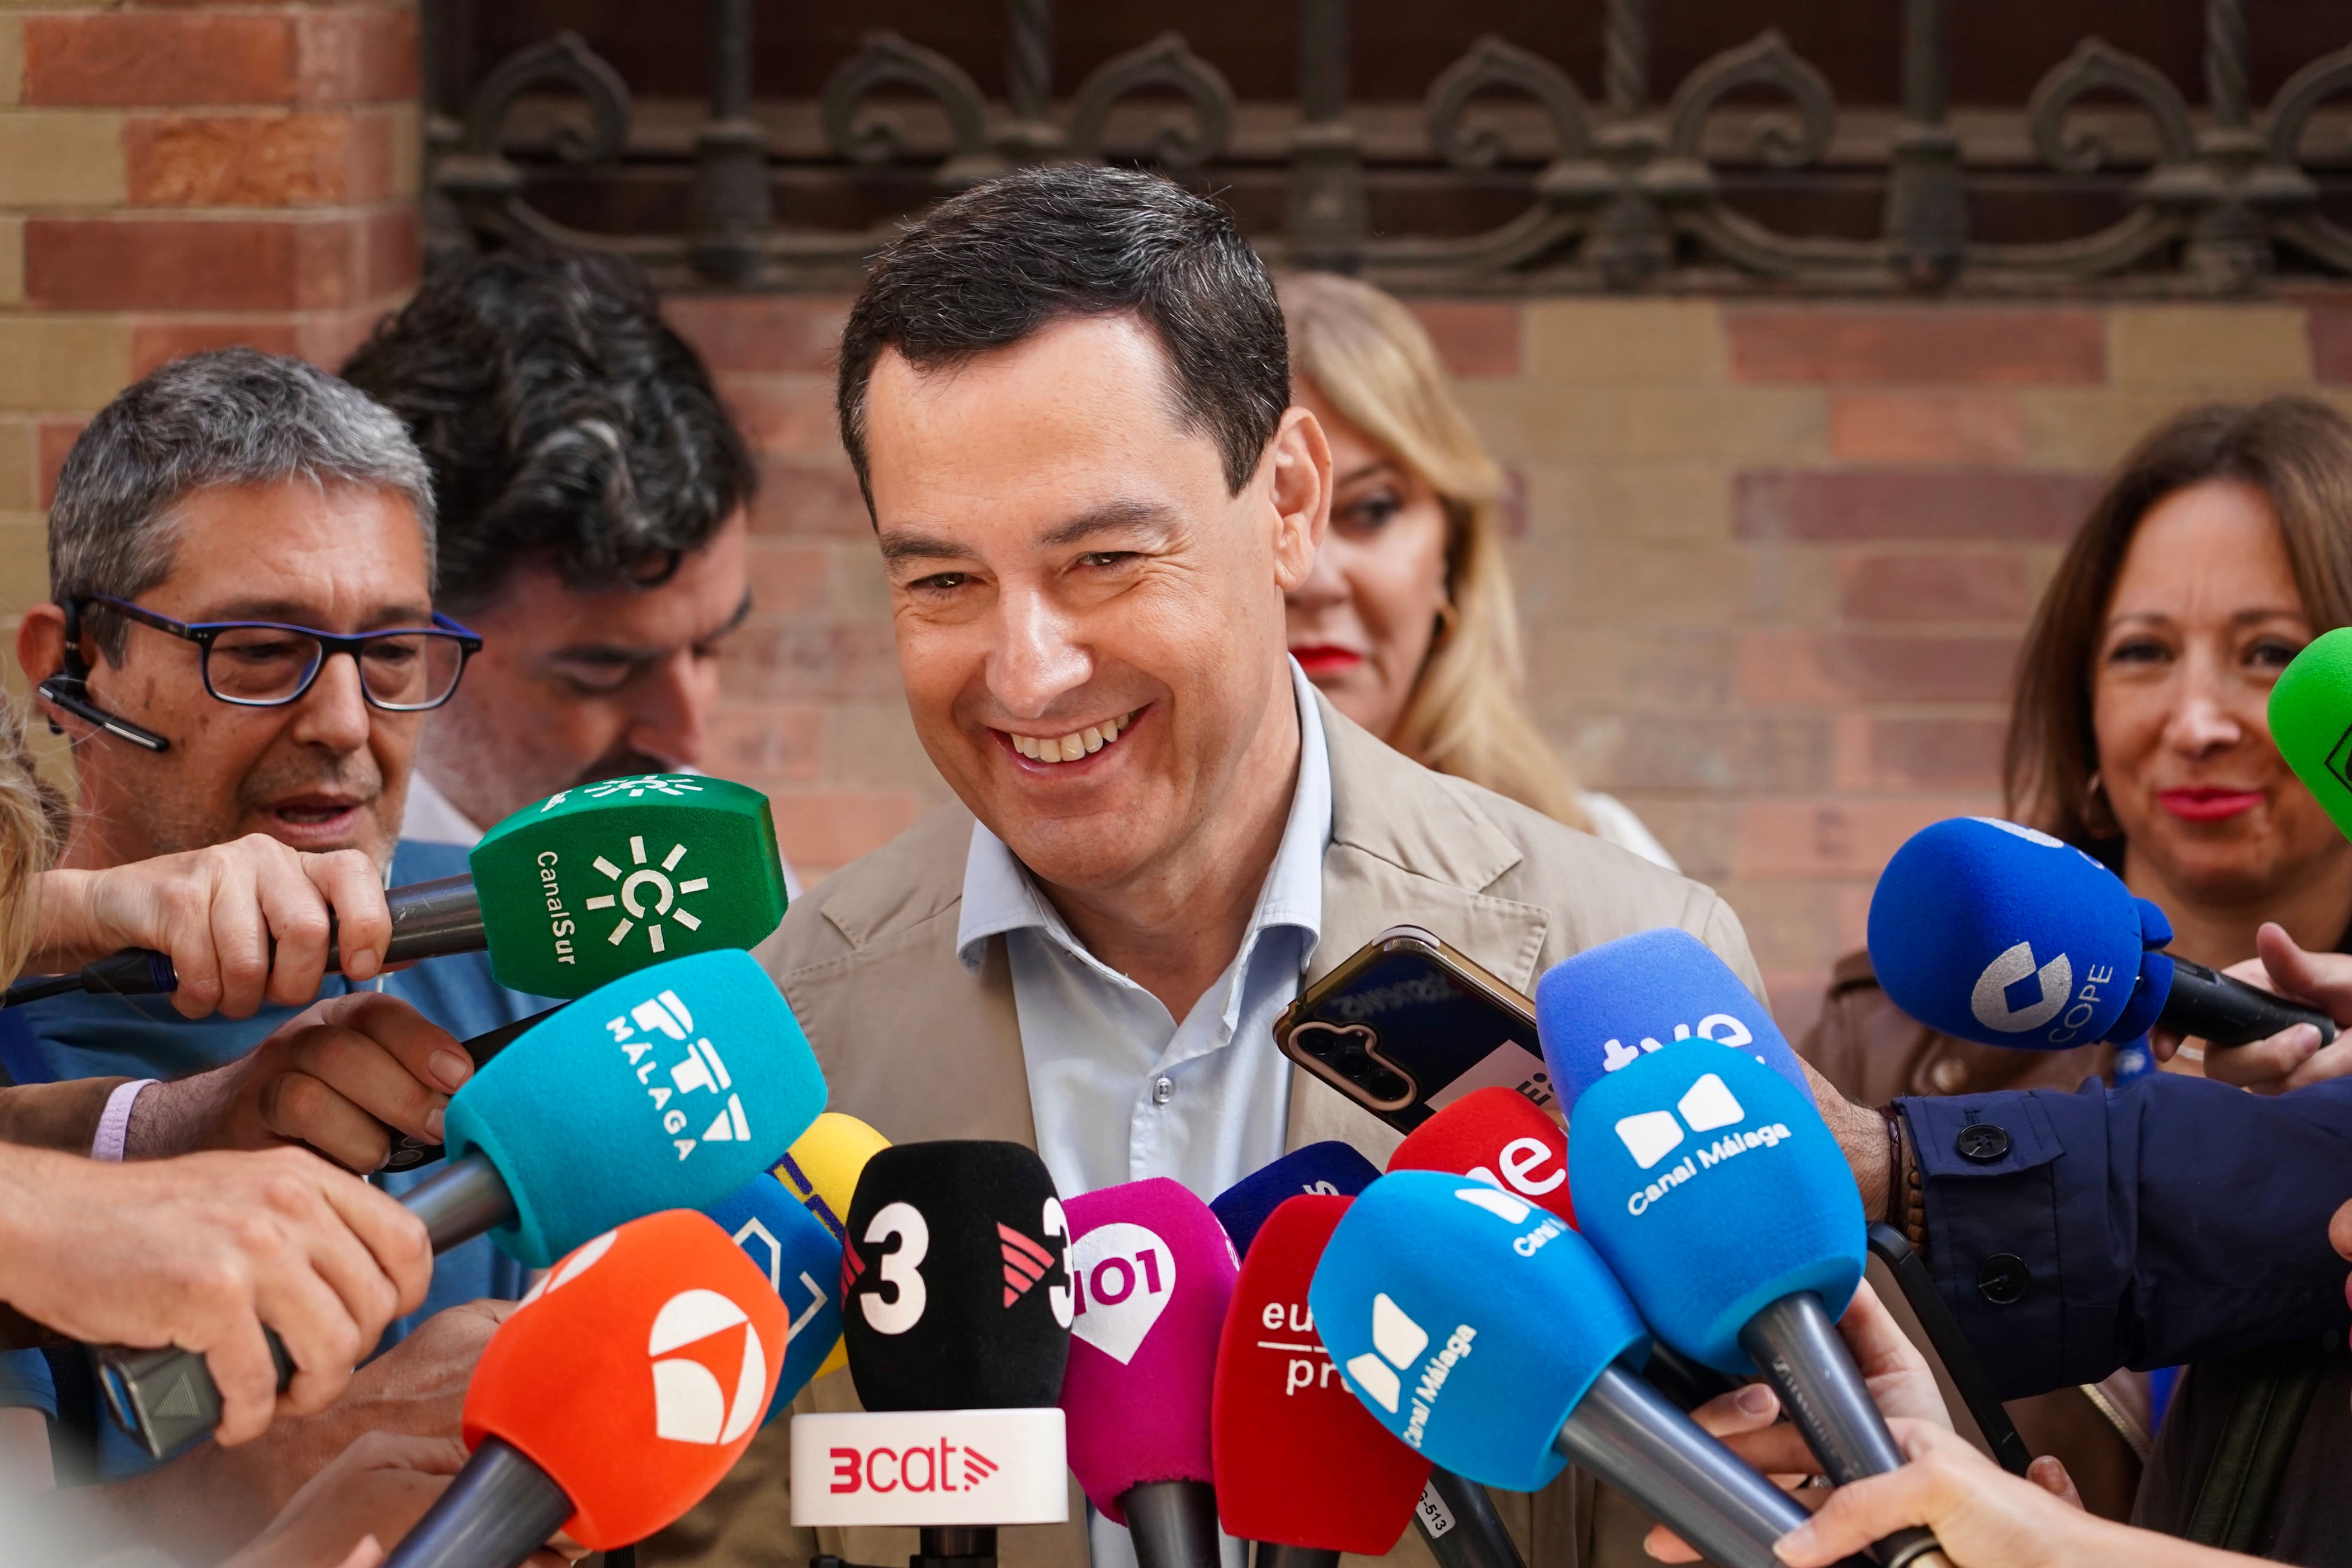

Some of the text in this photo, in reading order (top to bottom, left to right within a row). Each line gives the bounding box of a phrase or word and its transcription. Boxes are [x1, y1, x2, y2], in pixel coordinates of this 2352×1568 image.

[537, 851, 576, 965] CanalSur
[2048, 964, 2114, 1043] COPE
[606, 1015, 697, 1161] MÁLAGA
[1465, 1137, 1566, 1196] e
[1627, 1123, 1792, 1216] Canal Málaga
[860, 1202, 929, 1335] 3
[1286, 1359, 1354, 1396] pr
[1402, 1324, 1477, 1448] Canal Málaga
[829, 1437, 957, 1495] 3cat
